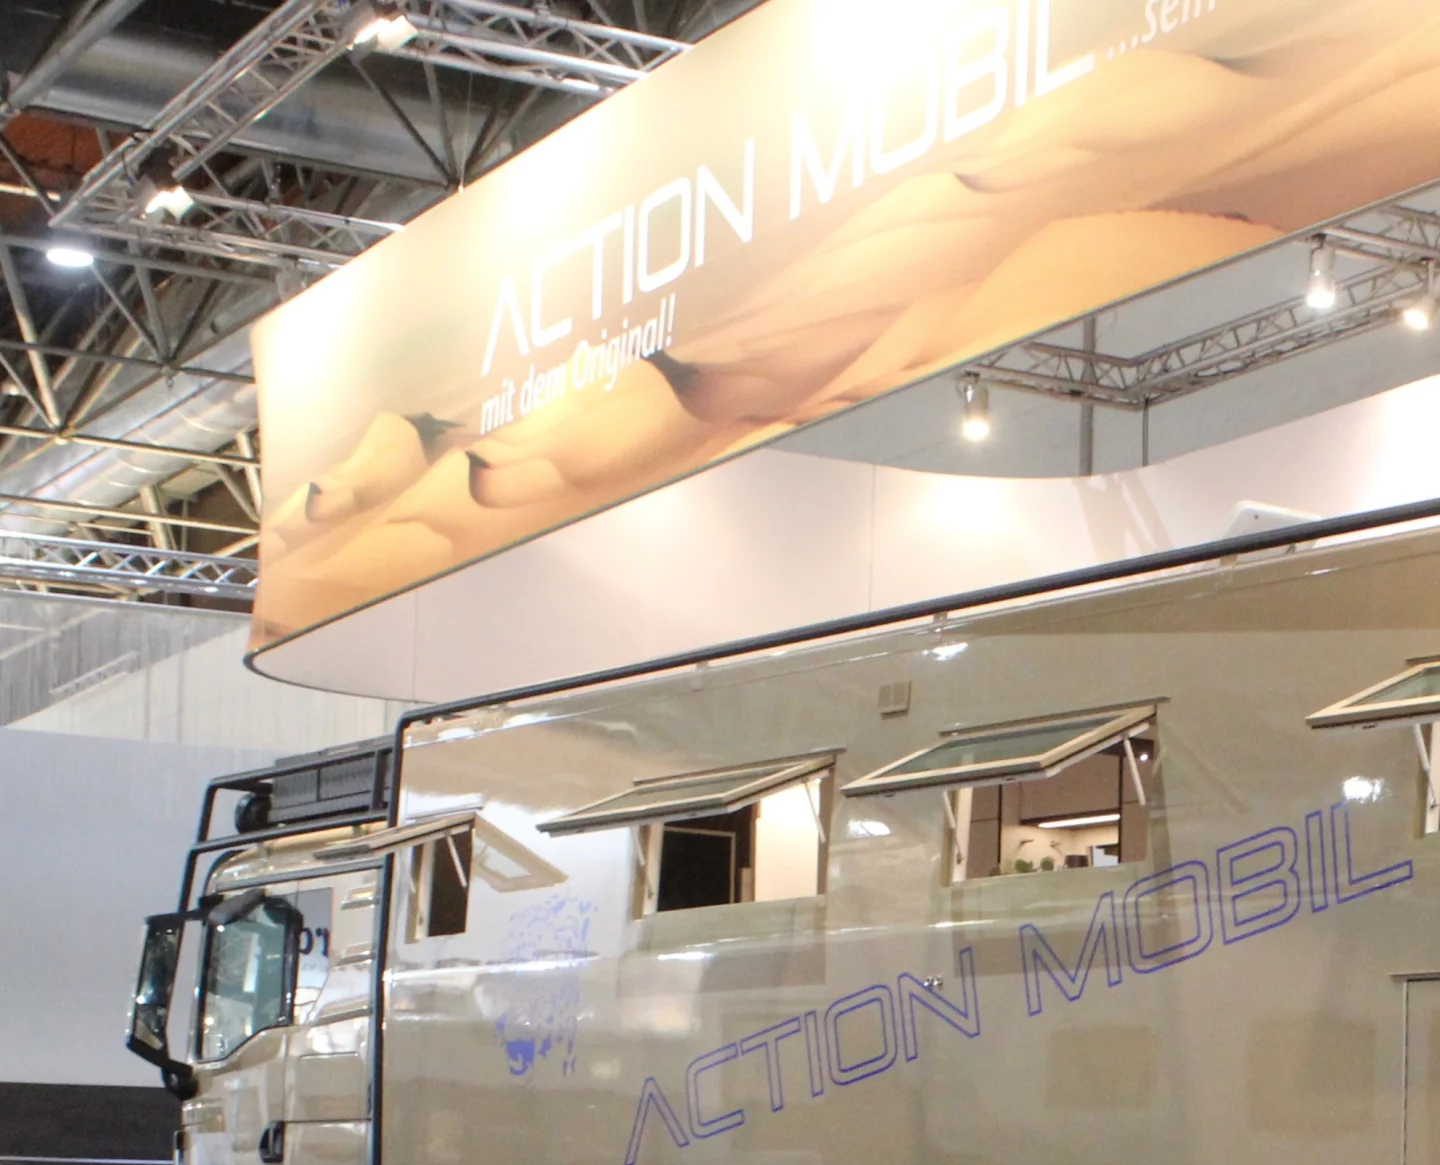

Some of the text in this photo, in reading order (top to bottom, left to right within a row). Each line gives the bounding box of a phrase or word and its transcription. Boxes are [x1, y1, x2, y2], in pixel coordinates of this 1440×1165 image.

[480, 0, 1096, 377] ACTION MOBIL
[480, 292, 677, 435] mit dem Original!
[1018, 800, 1414, 1017] MOBIL
